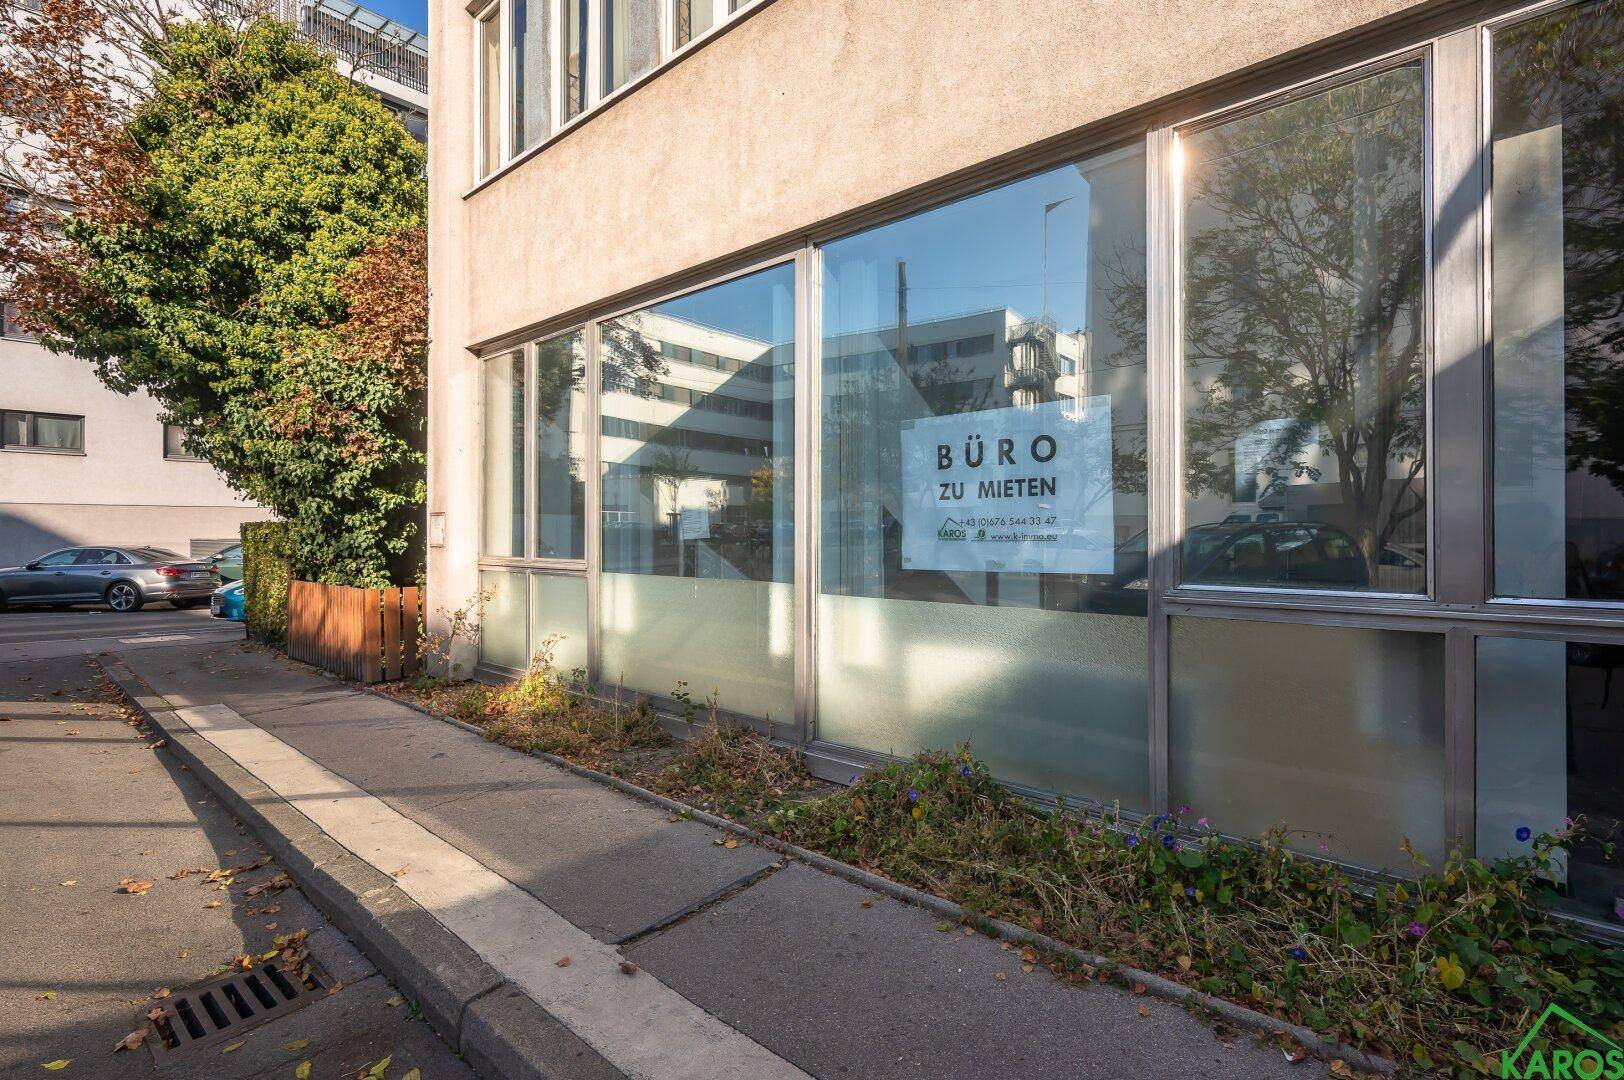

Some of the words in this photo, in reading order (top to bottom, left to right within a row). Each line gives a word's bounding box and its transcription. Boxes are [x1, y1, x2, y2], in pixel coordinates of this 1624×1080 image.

[937, 434, 1057, 470] BÜRO
[939, 482, 964, 501] ZU
[978, 477, 1056, 499] MIETEN
[959, 517, 976, 527] +43
[978, 517, 1006, 527] (0)676
[1009, 517, 1026, 526] 544
[1029, 517, 1041, 526] 33
[1045, 516, 1057, 525] 47
[938, 529, 967, 538] KAROS
[990, 532, 1058, 540] www.k-immo.eu
